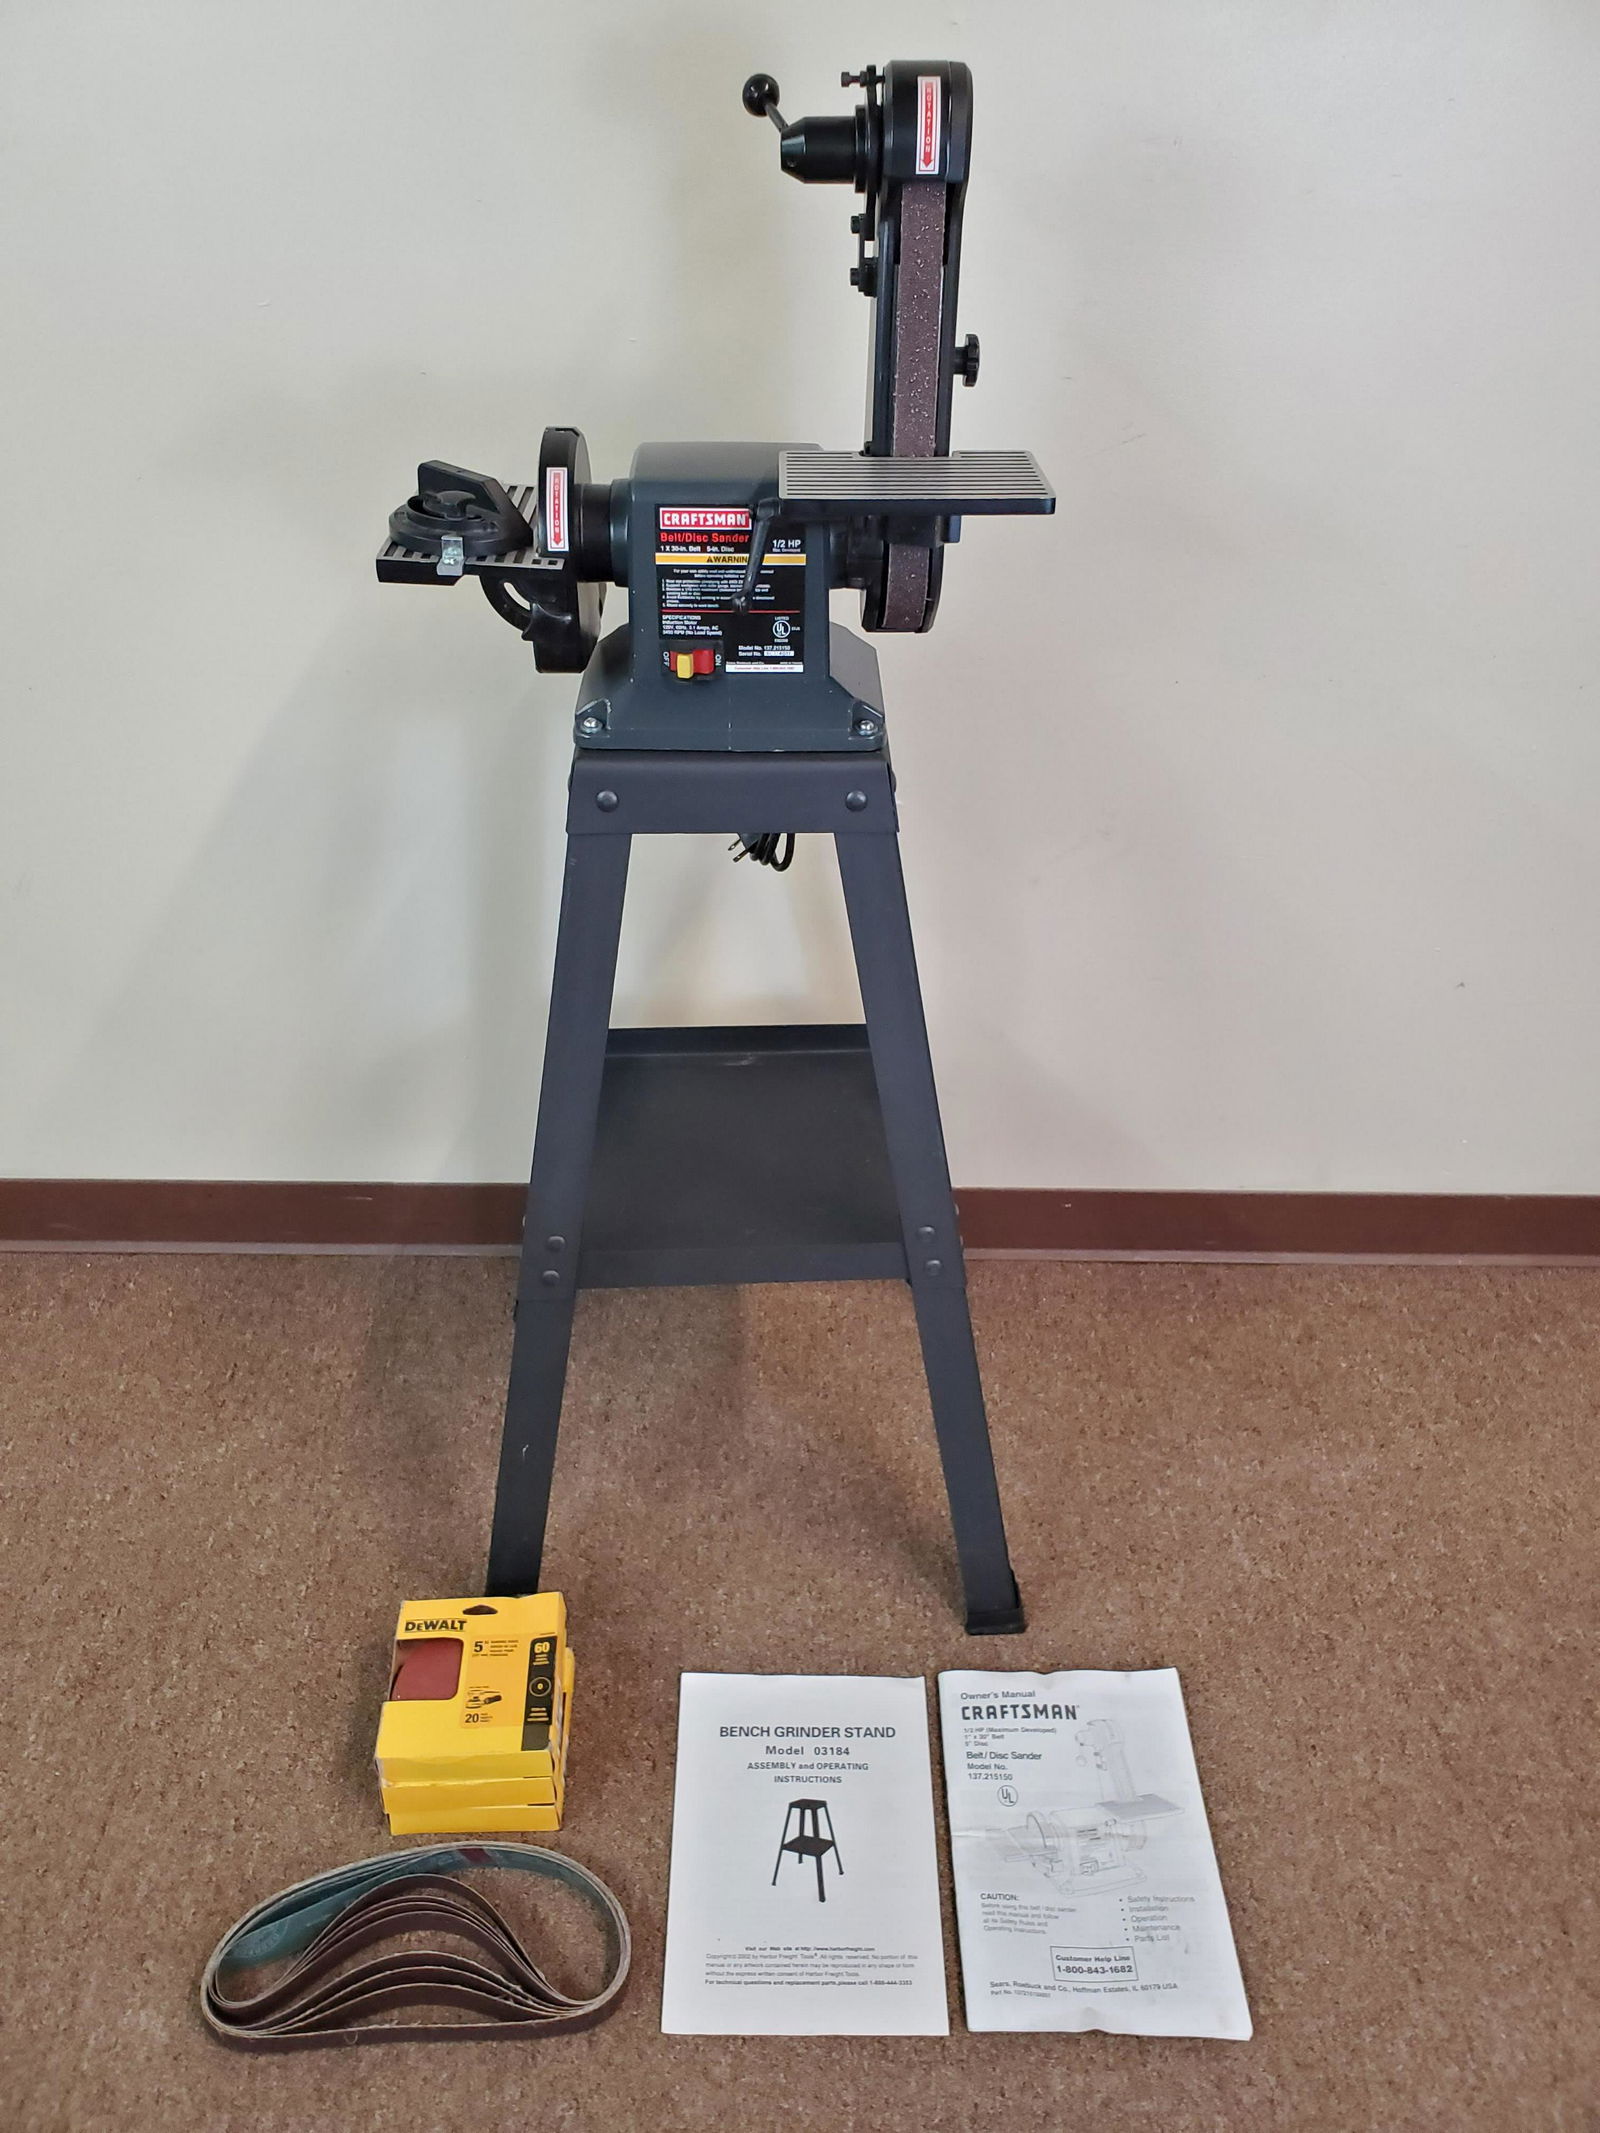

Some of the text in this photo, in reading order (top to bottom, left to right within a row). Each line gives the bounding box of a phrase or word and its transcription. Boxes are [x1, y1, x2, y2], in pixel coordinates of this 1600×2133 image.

[664, 513, 746, 526] CRAFTSMAN
[660, 532, 749, 542] Belt/Disc Sander
[773, 540, 801, 548] 1/2 HP
[715, 654, 722, 666] ON
[534, 1642, 550, 1654] 60
[960, 1690, 1036, 1700] Owner's Manual
[962, 1704, 1078, 1720] CRAFTSMAN
[465, 1713, 479, 1724] 20
[720, 1726, 896, 1738] BENCH GRINDER STAND
[766, 1746, 850, 1756] Model 03184
[989, 1752, 1008, 1760] Disc
[1010, 1752, 1042, 1760] Sander
[747, 1762, 869, 1771] ASSEMBLY and OPERATING
[774, 1776, 842, 1784] INSTRUCTIONS
[968, 1772, 1014, 1780] 137.215150
[1057, 1964, 1133, 1974] 1-800-843-1682
